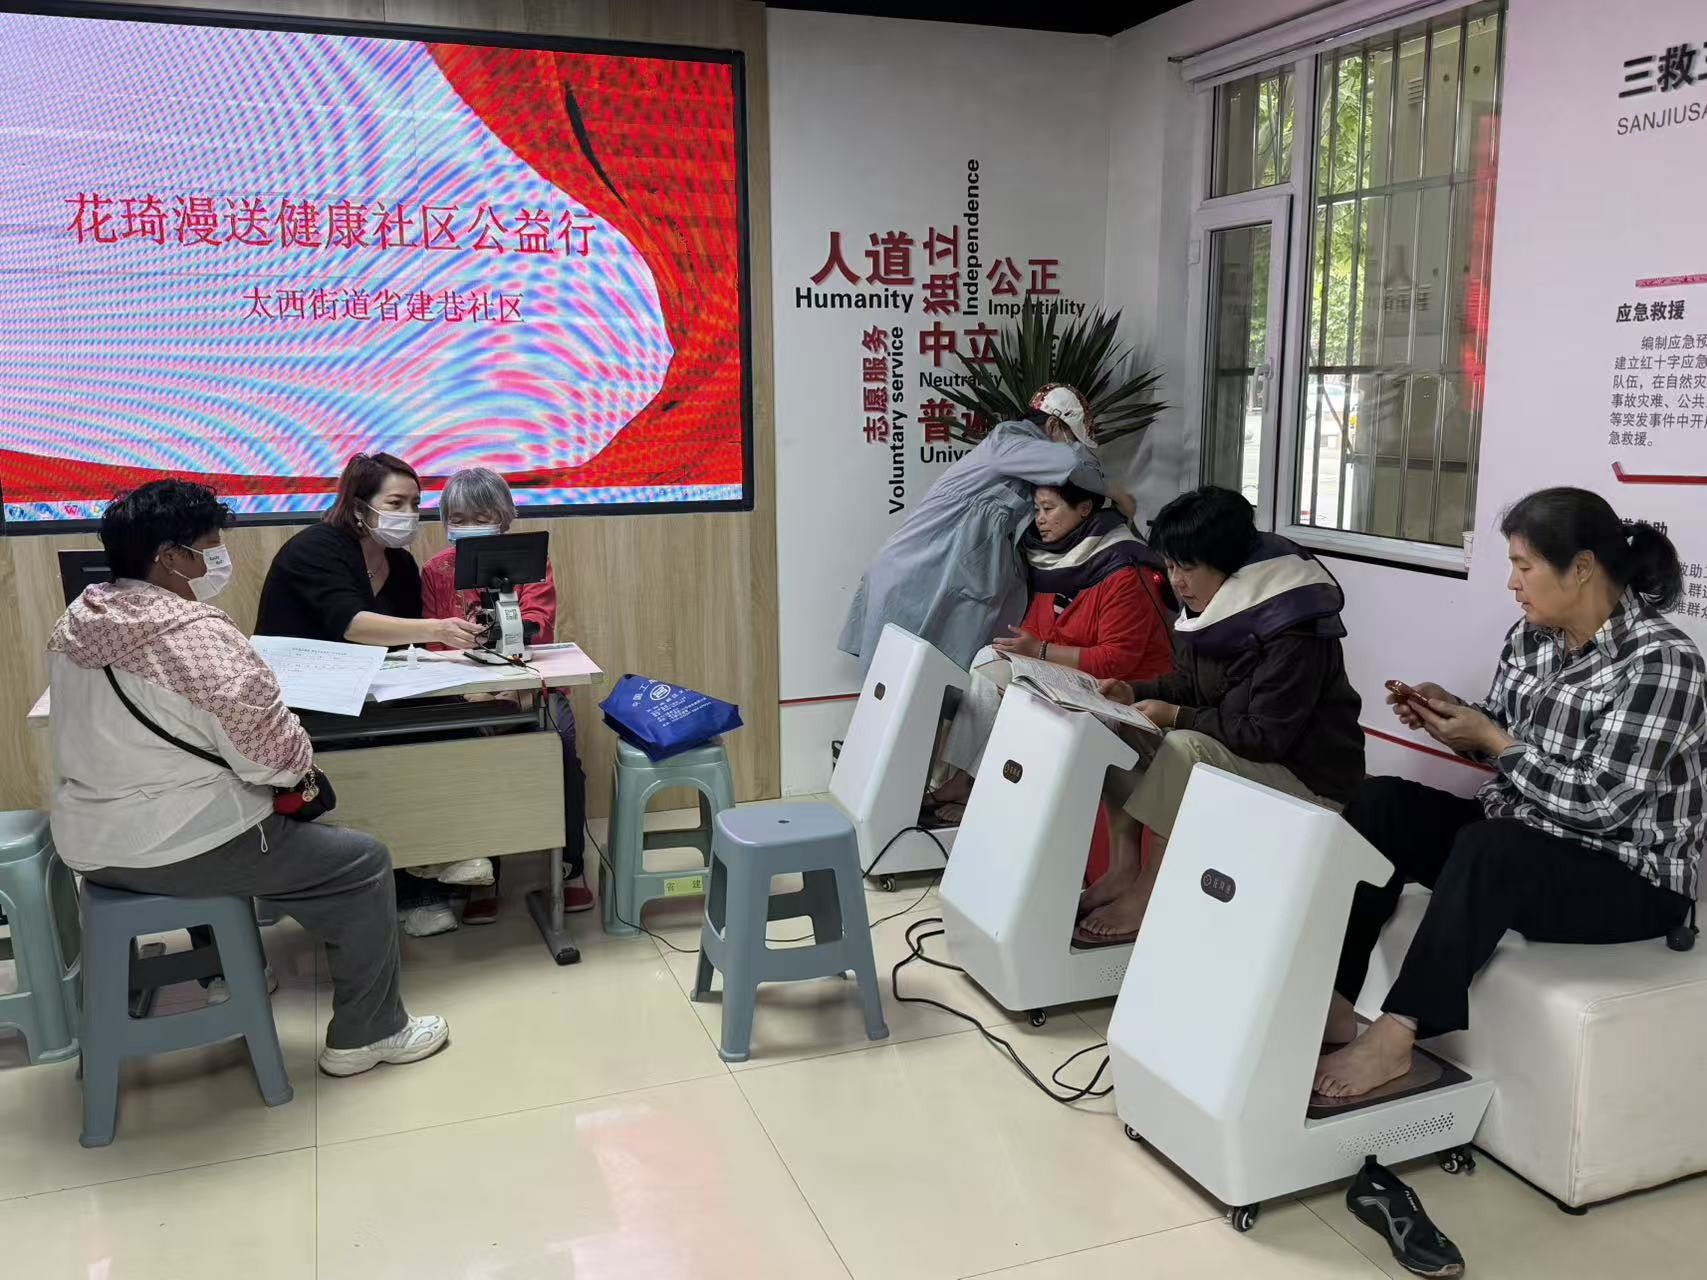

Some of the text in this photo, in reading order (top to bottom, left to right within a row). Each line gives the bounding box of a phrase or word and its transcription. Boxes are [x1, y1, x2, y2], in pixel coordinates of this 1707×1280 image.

[64, 193, 597, 257] 花琦漫送健康社区公益行
[962, 159, 983, 316] Independence
[810, 230, 914, 285] 人道
[920, 225, 961, 316] 独立
[986, 257, 1063, 297] 公正
[243, 287, 525, 323] 太西街道省建巷社区
[795, 287, 914, 313] Humanity
[988, 299, 1086, 318] Imprtility
[1615, 300, 1686, 323] 应急救援
[919, 321, 999, 367] 中立
[863, 325, 890, 443] 志愿服务
[919, 372, 1003, 388] Neutray
[888, 326, 908, 514] Voluntary service
[1611, 393, 1707, 409] 事故灾难、公共
[1610, 412, 1707, 429] 等突发事件中开
[920, 446, 973, 463] Univ
